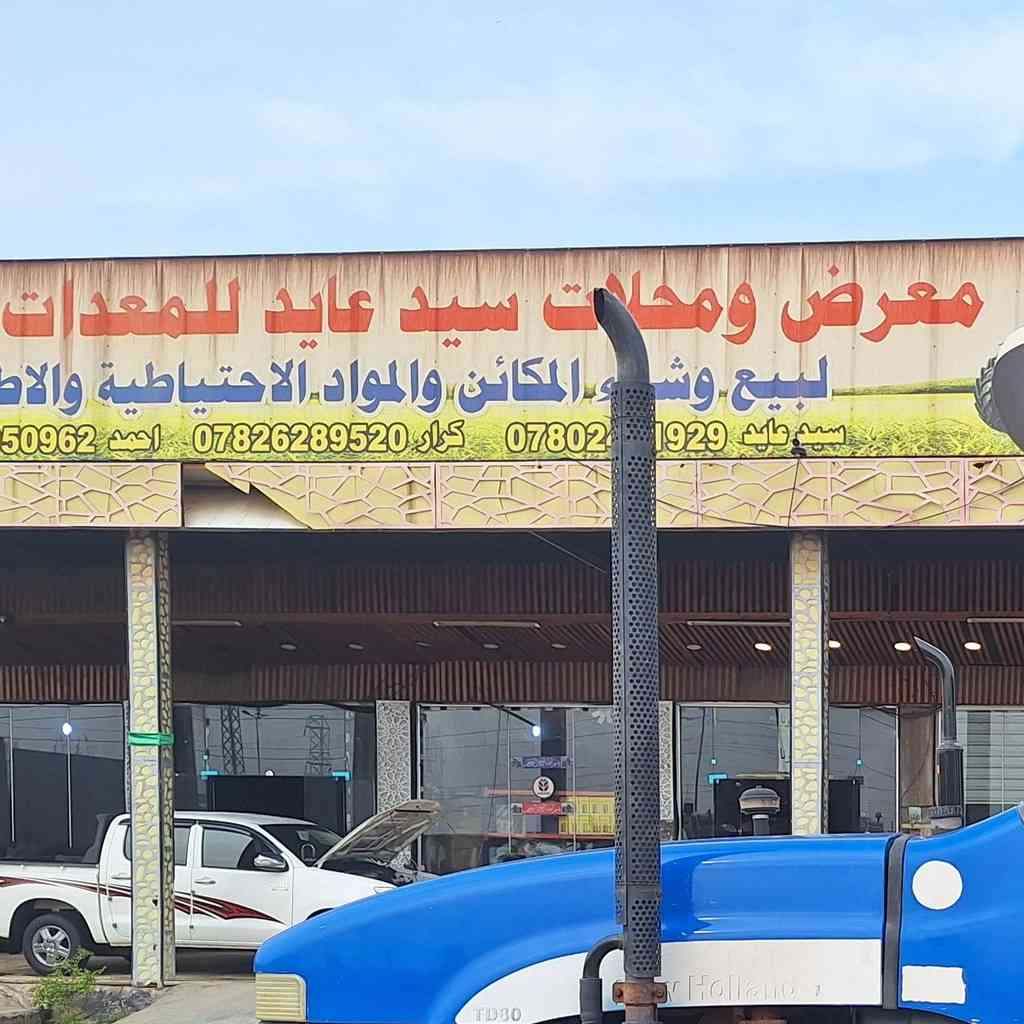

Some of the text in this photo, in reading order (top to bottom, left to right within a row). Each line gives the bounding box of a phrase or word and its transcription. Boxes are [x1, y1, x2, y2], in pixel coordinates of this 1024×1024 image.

[2, 276, 240, 340] للمعدات
[264, 274, 374, 349] عايد
[400, 285, 519, 349] سيد
[781, 264, 984, 343] معرض
[98, 359, 306, 415] الاحتياطية
[323, 358, 442, 414] والمواد
[597, 356, 714, 412] وشء
[731, 355, 829, 411] لبيع
[107, 423, 161, 452] احمد
[193, 422, 408, 454] 07826289520
[505, 420, 728, 453] 078021929
[741, 417, 846, 452] سيد عايد
